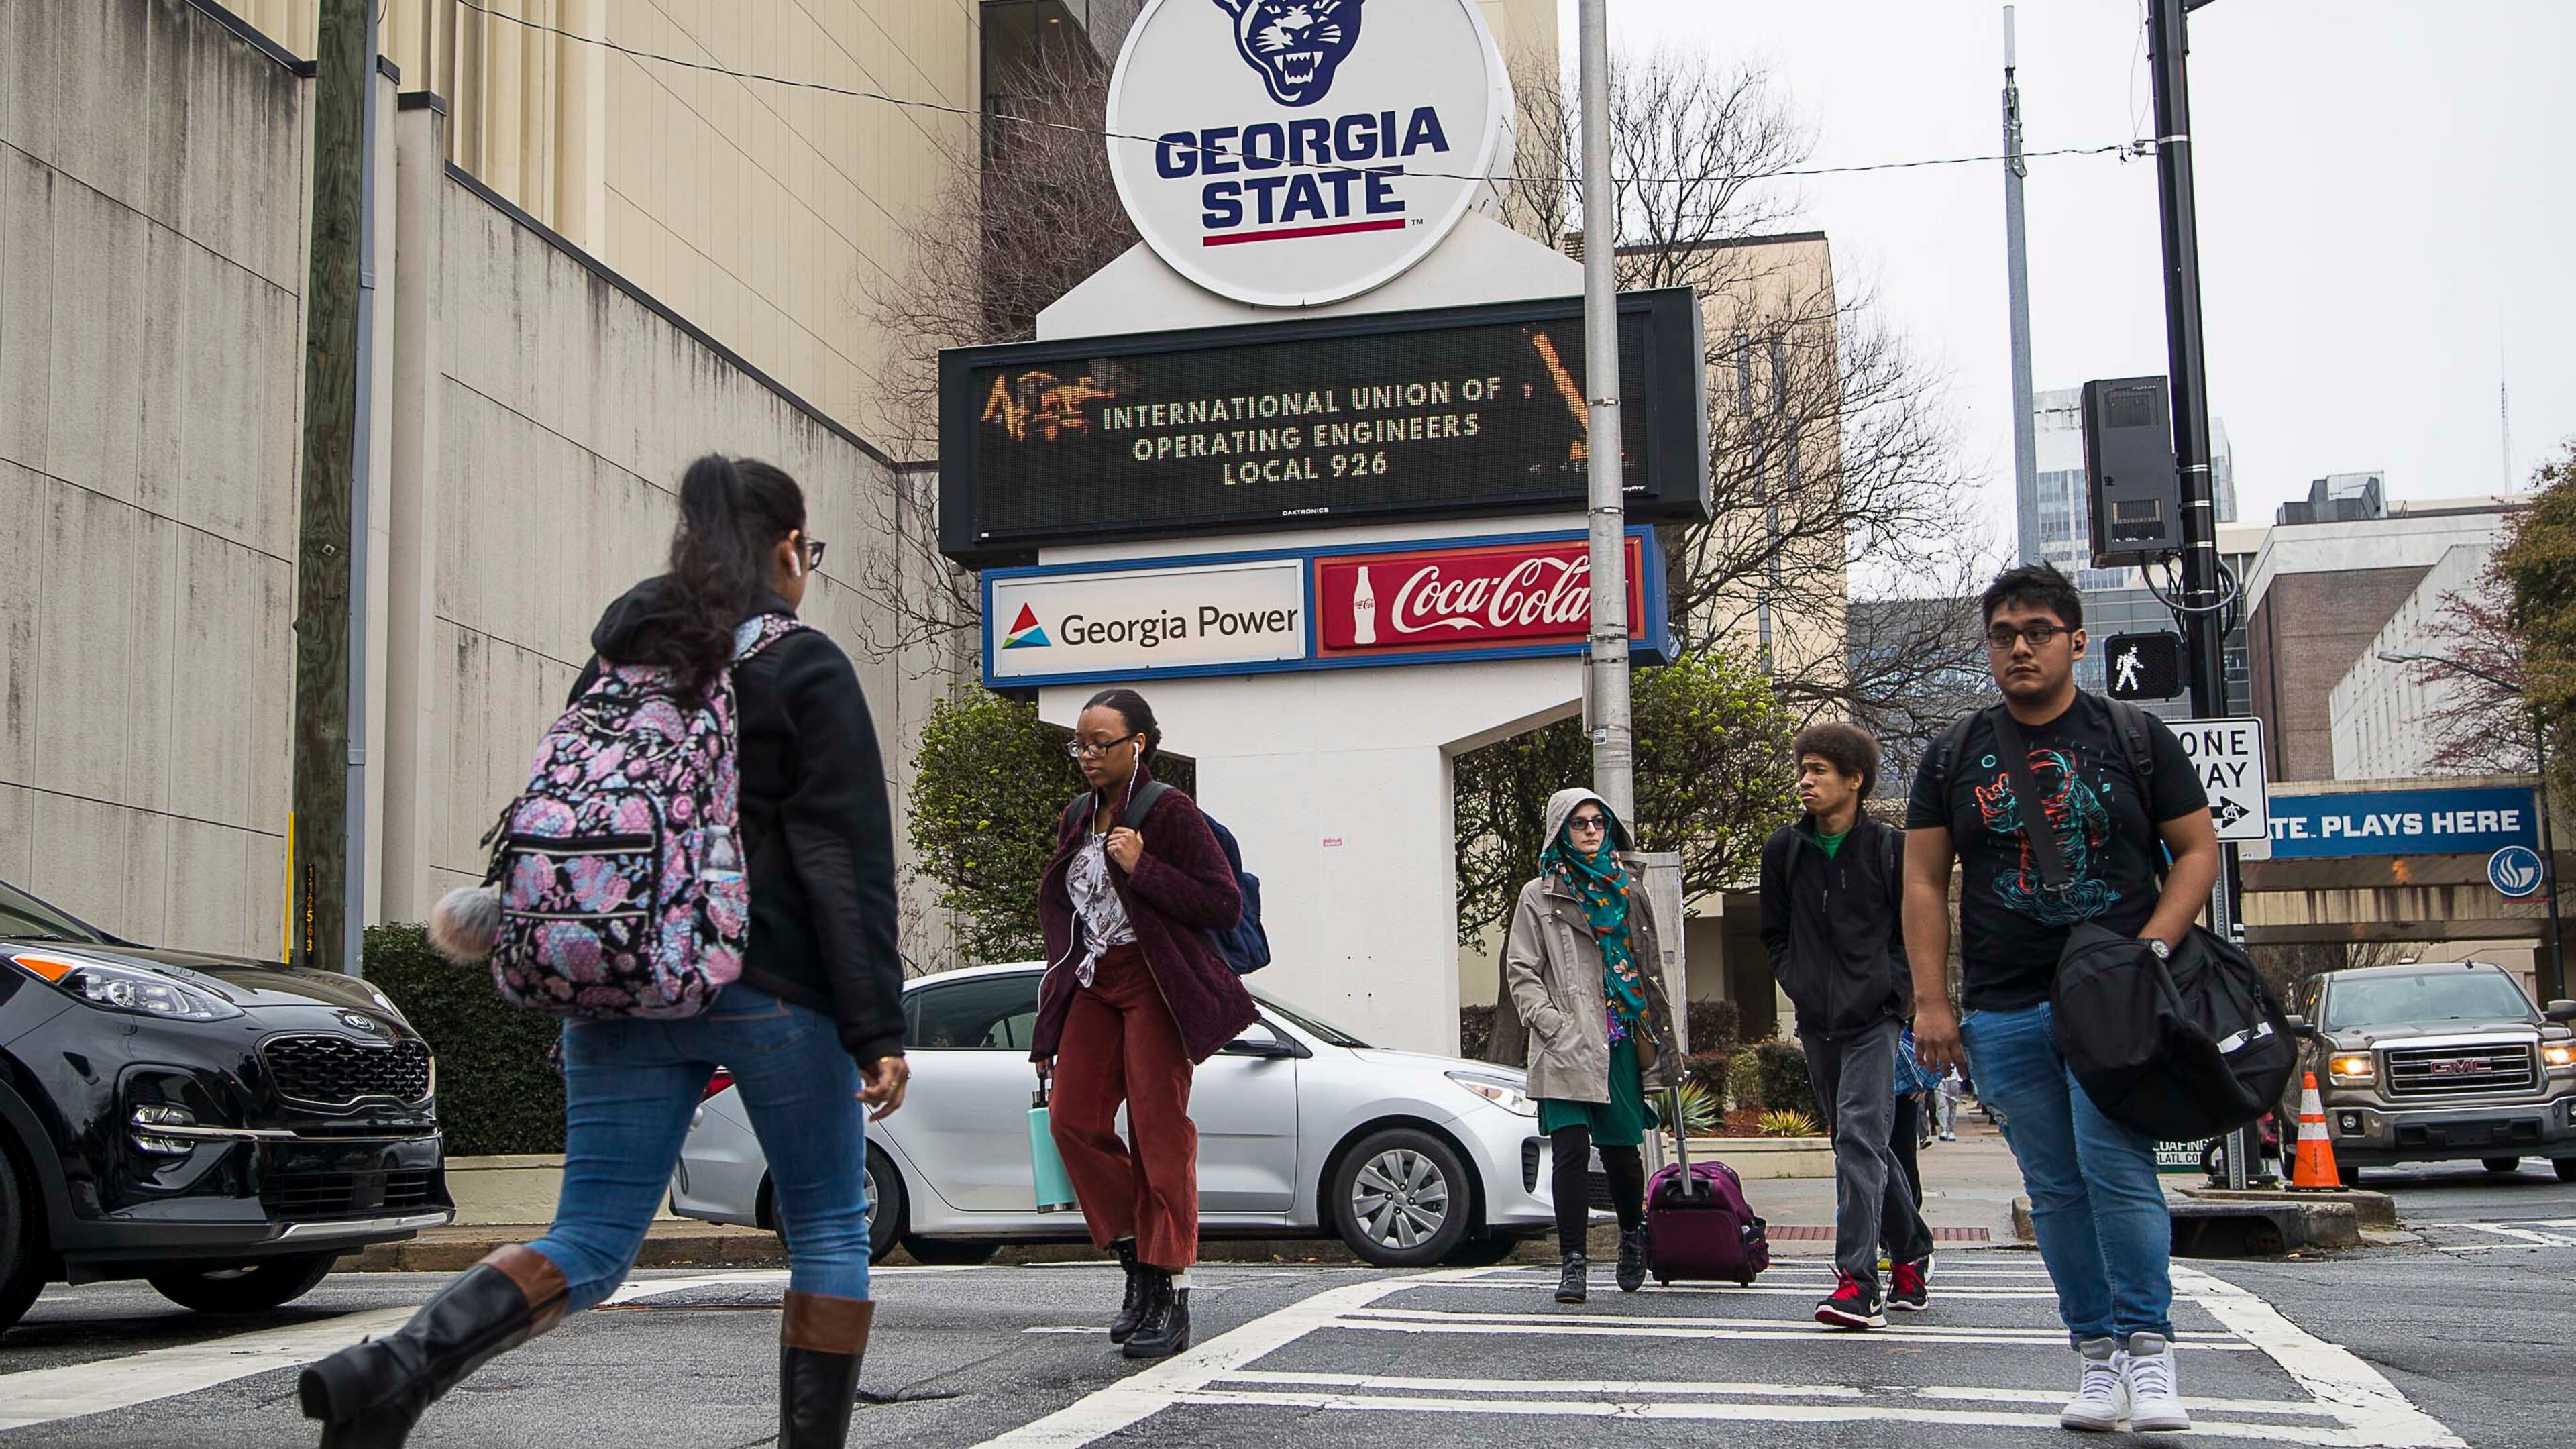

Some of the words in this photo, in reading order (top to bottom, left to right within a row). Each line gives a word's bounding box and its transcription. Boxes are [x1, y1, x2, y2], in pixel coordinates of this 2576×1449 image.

[1155, 106, 1450, 179] GEORGIA
[1202, 166, 1405, 229] STATE
[1104, 390, 1340, 429] INTERNATIONAL
[1352, 380, 1450, 410] UNION
[1462, 376, 1501, 402] OF
[1132, 427, 1301, 461] OPERATING
[1314, 413, 1481, 447] ENGINEERS
[1224, 457, 1318, 486] LOCAL
[1330, 451, 1389, 478] 926
[1061, 609, 1187, 648] Georgia
[1199, 606, 1298, 638] Power
[2179, 730, 2249, 757] ONE
[2196, 762, 2248, 789] AY
[2269, 816, 2317, 840] TE.
[2322, 812, 2423, 838] PLAYS
[2432, 810, 2520, 835] HERE
[2430, 1059, 2492, 1074] GMC
